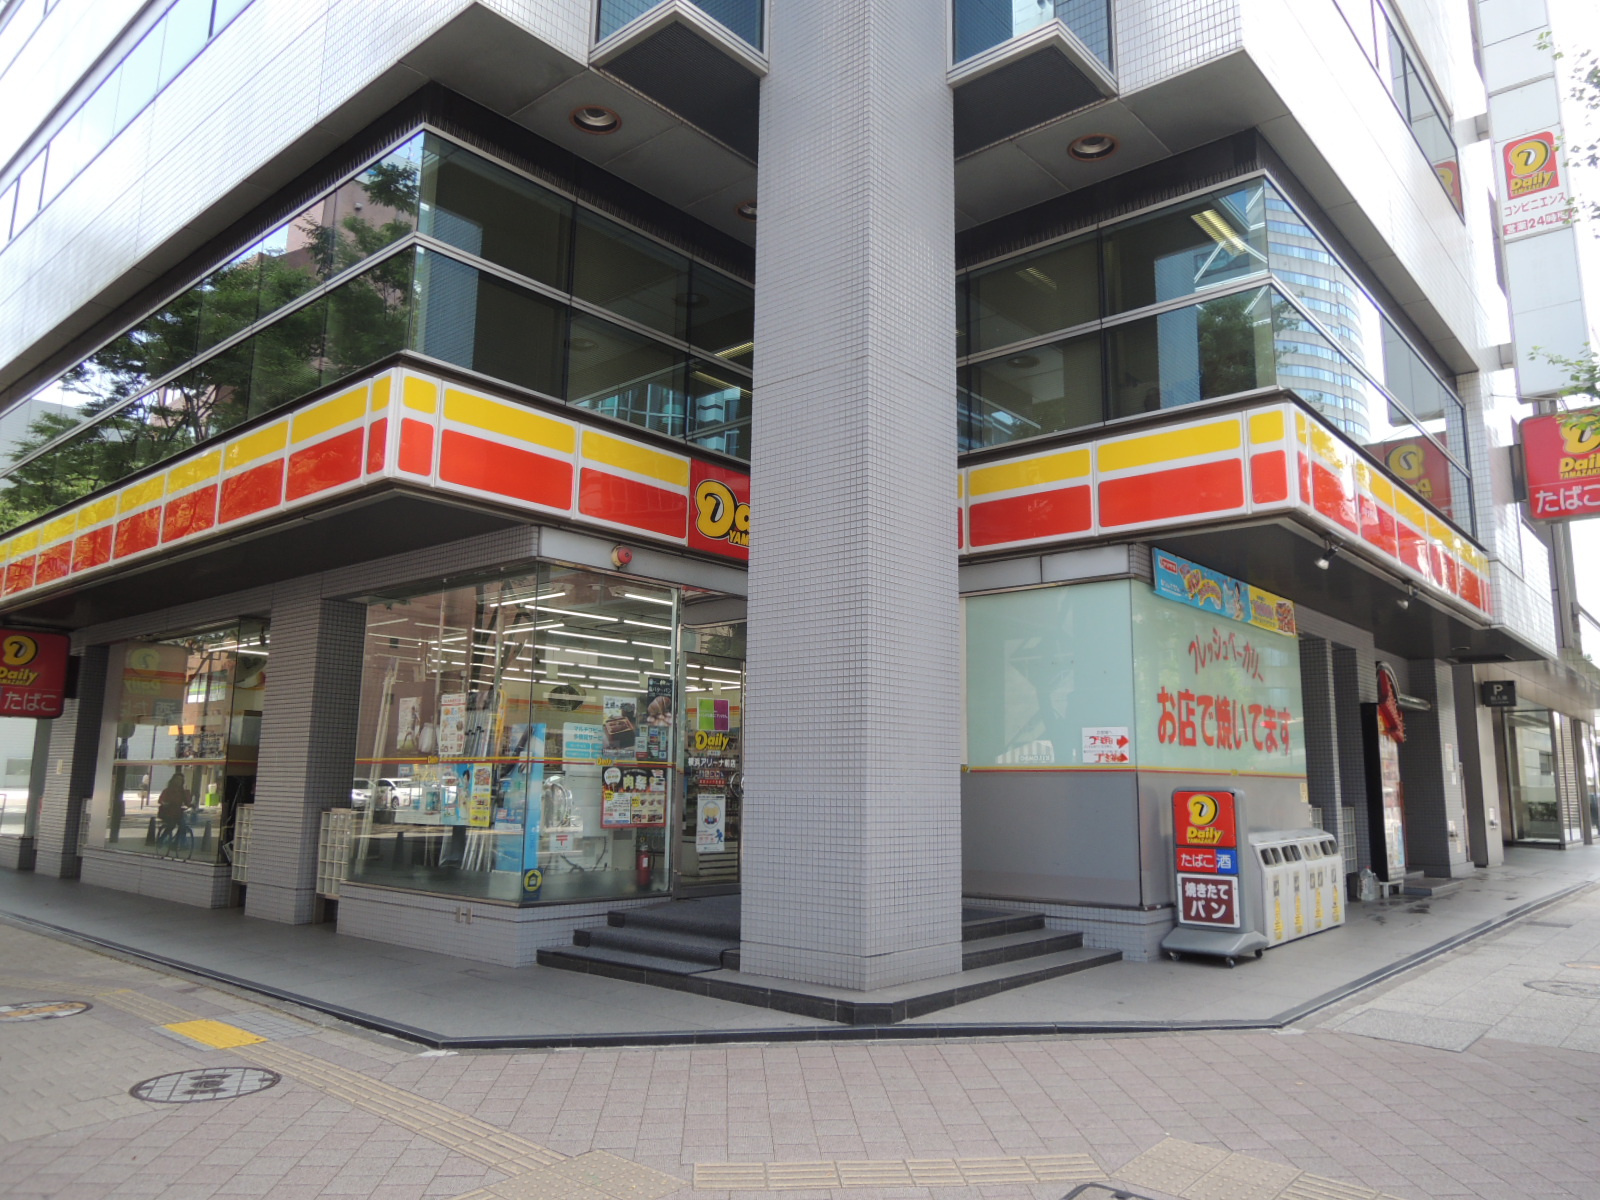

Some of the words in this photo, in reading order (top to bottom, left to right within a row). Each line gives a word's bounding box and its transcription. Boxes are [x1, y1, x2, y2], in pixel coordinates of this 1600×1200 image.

[1511, 171, 1555, 190] Daily
[1504, 192, 1567, 217] コンビニエンス
[1493, 684, 1504, 695] P
[4, 691, 57, 712] たばこ
[1157, 686, 1291, 756] お店で焼いてます
[695, 730, 730, 751] Daily
[1187, 826, 1223, 844] Daily
[1181, 853, 1215, 868] たばこ
[1217, 854, 1232, 869] 酒
[1184, 881, 1229, 900] 焼きたて
[1190, 900, 1226, 919] パン
